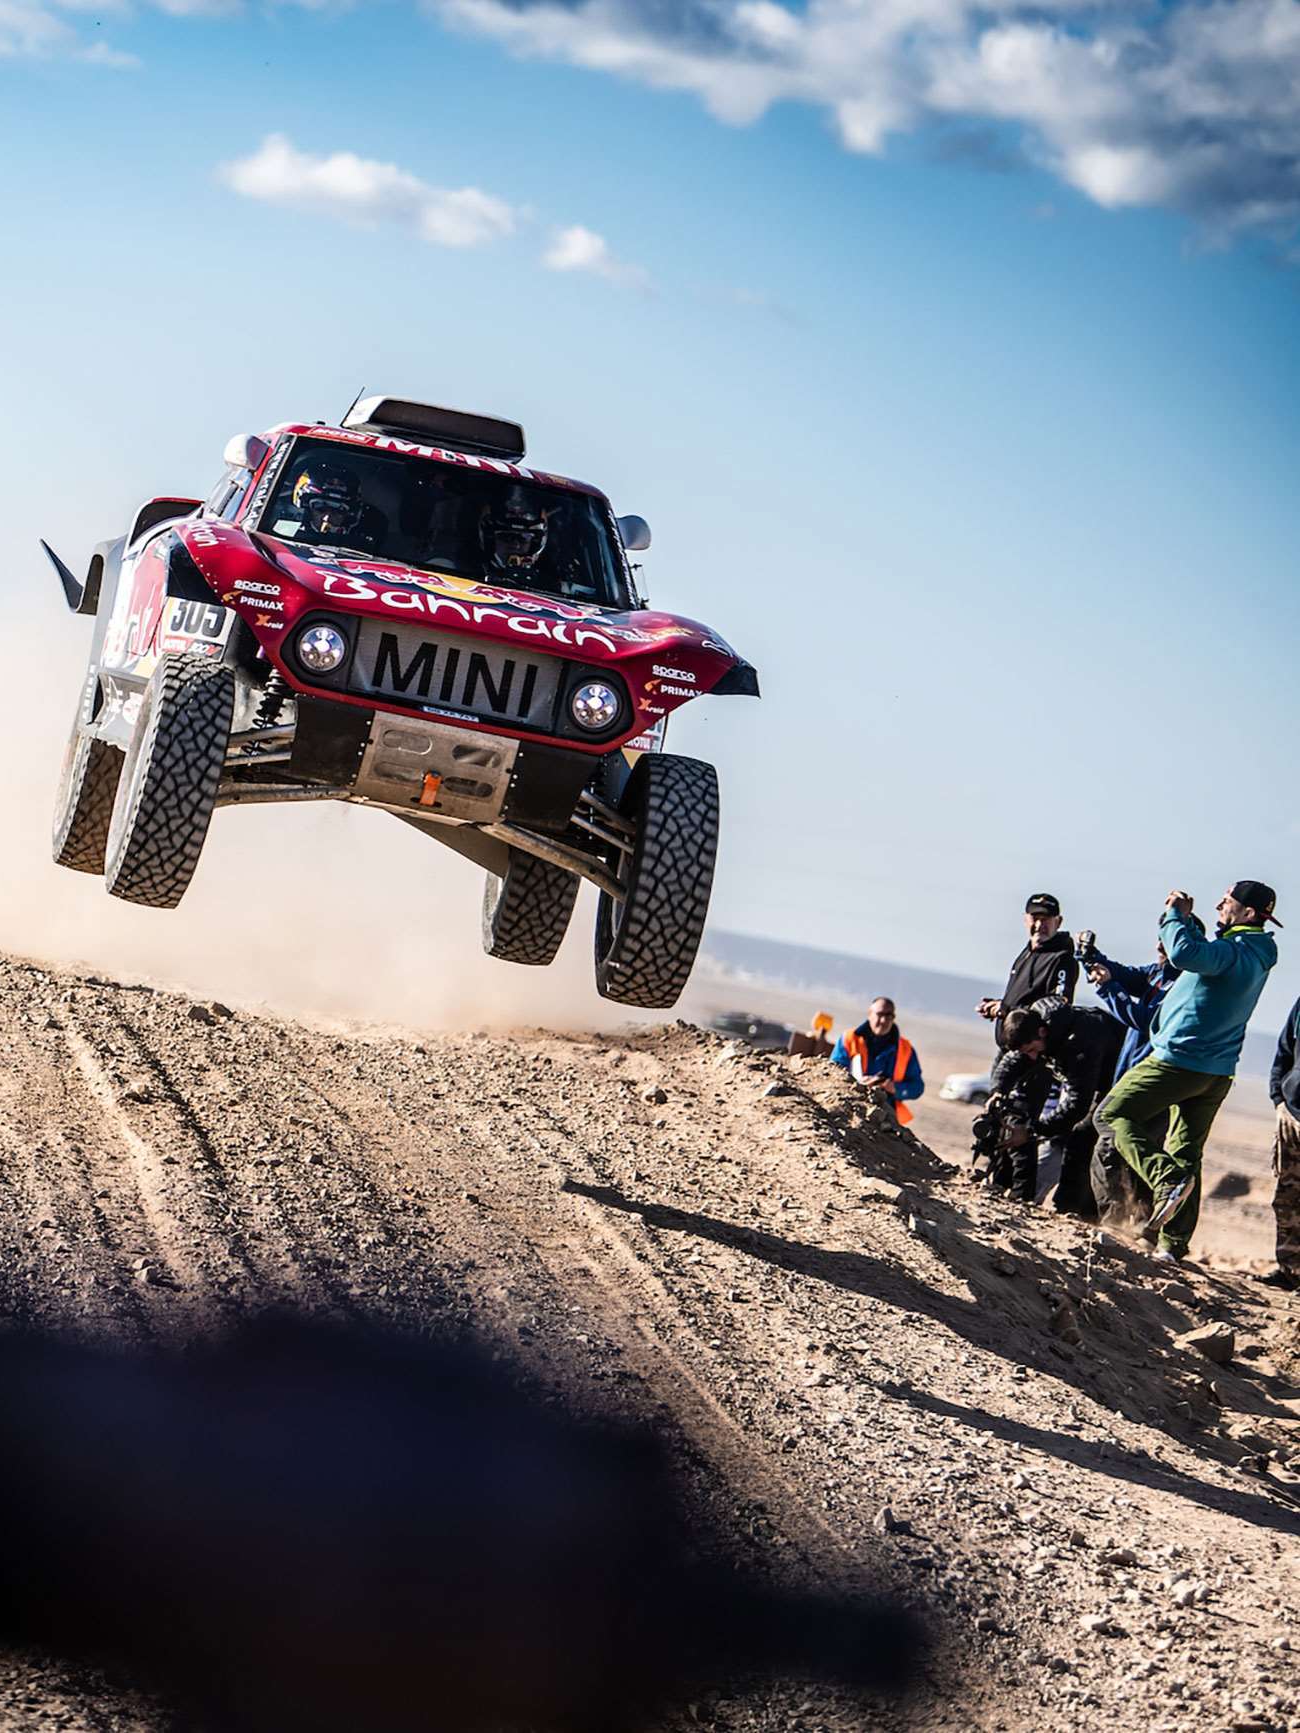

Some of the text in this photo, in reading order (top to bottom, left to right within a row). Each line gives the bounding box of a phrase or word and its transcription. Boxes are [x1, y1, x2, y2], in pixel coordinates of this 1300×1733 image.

[234, 579, 281, 596] sparco
[240, 595, 284, 611] PRIMAX
[315, 570, 617, 653] Bahrain
[170, 601, 227, 638] 305
[371, 631, 538, 718] MINI
[652, 664, 696, 683] sparco
